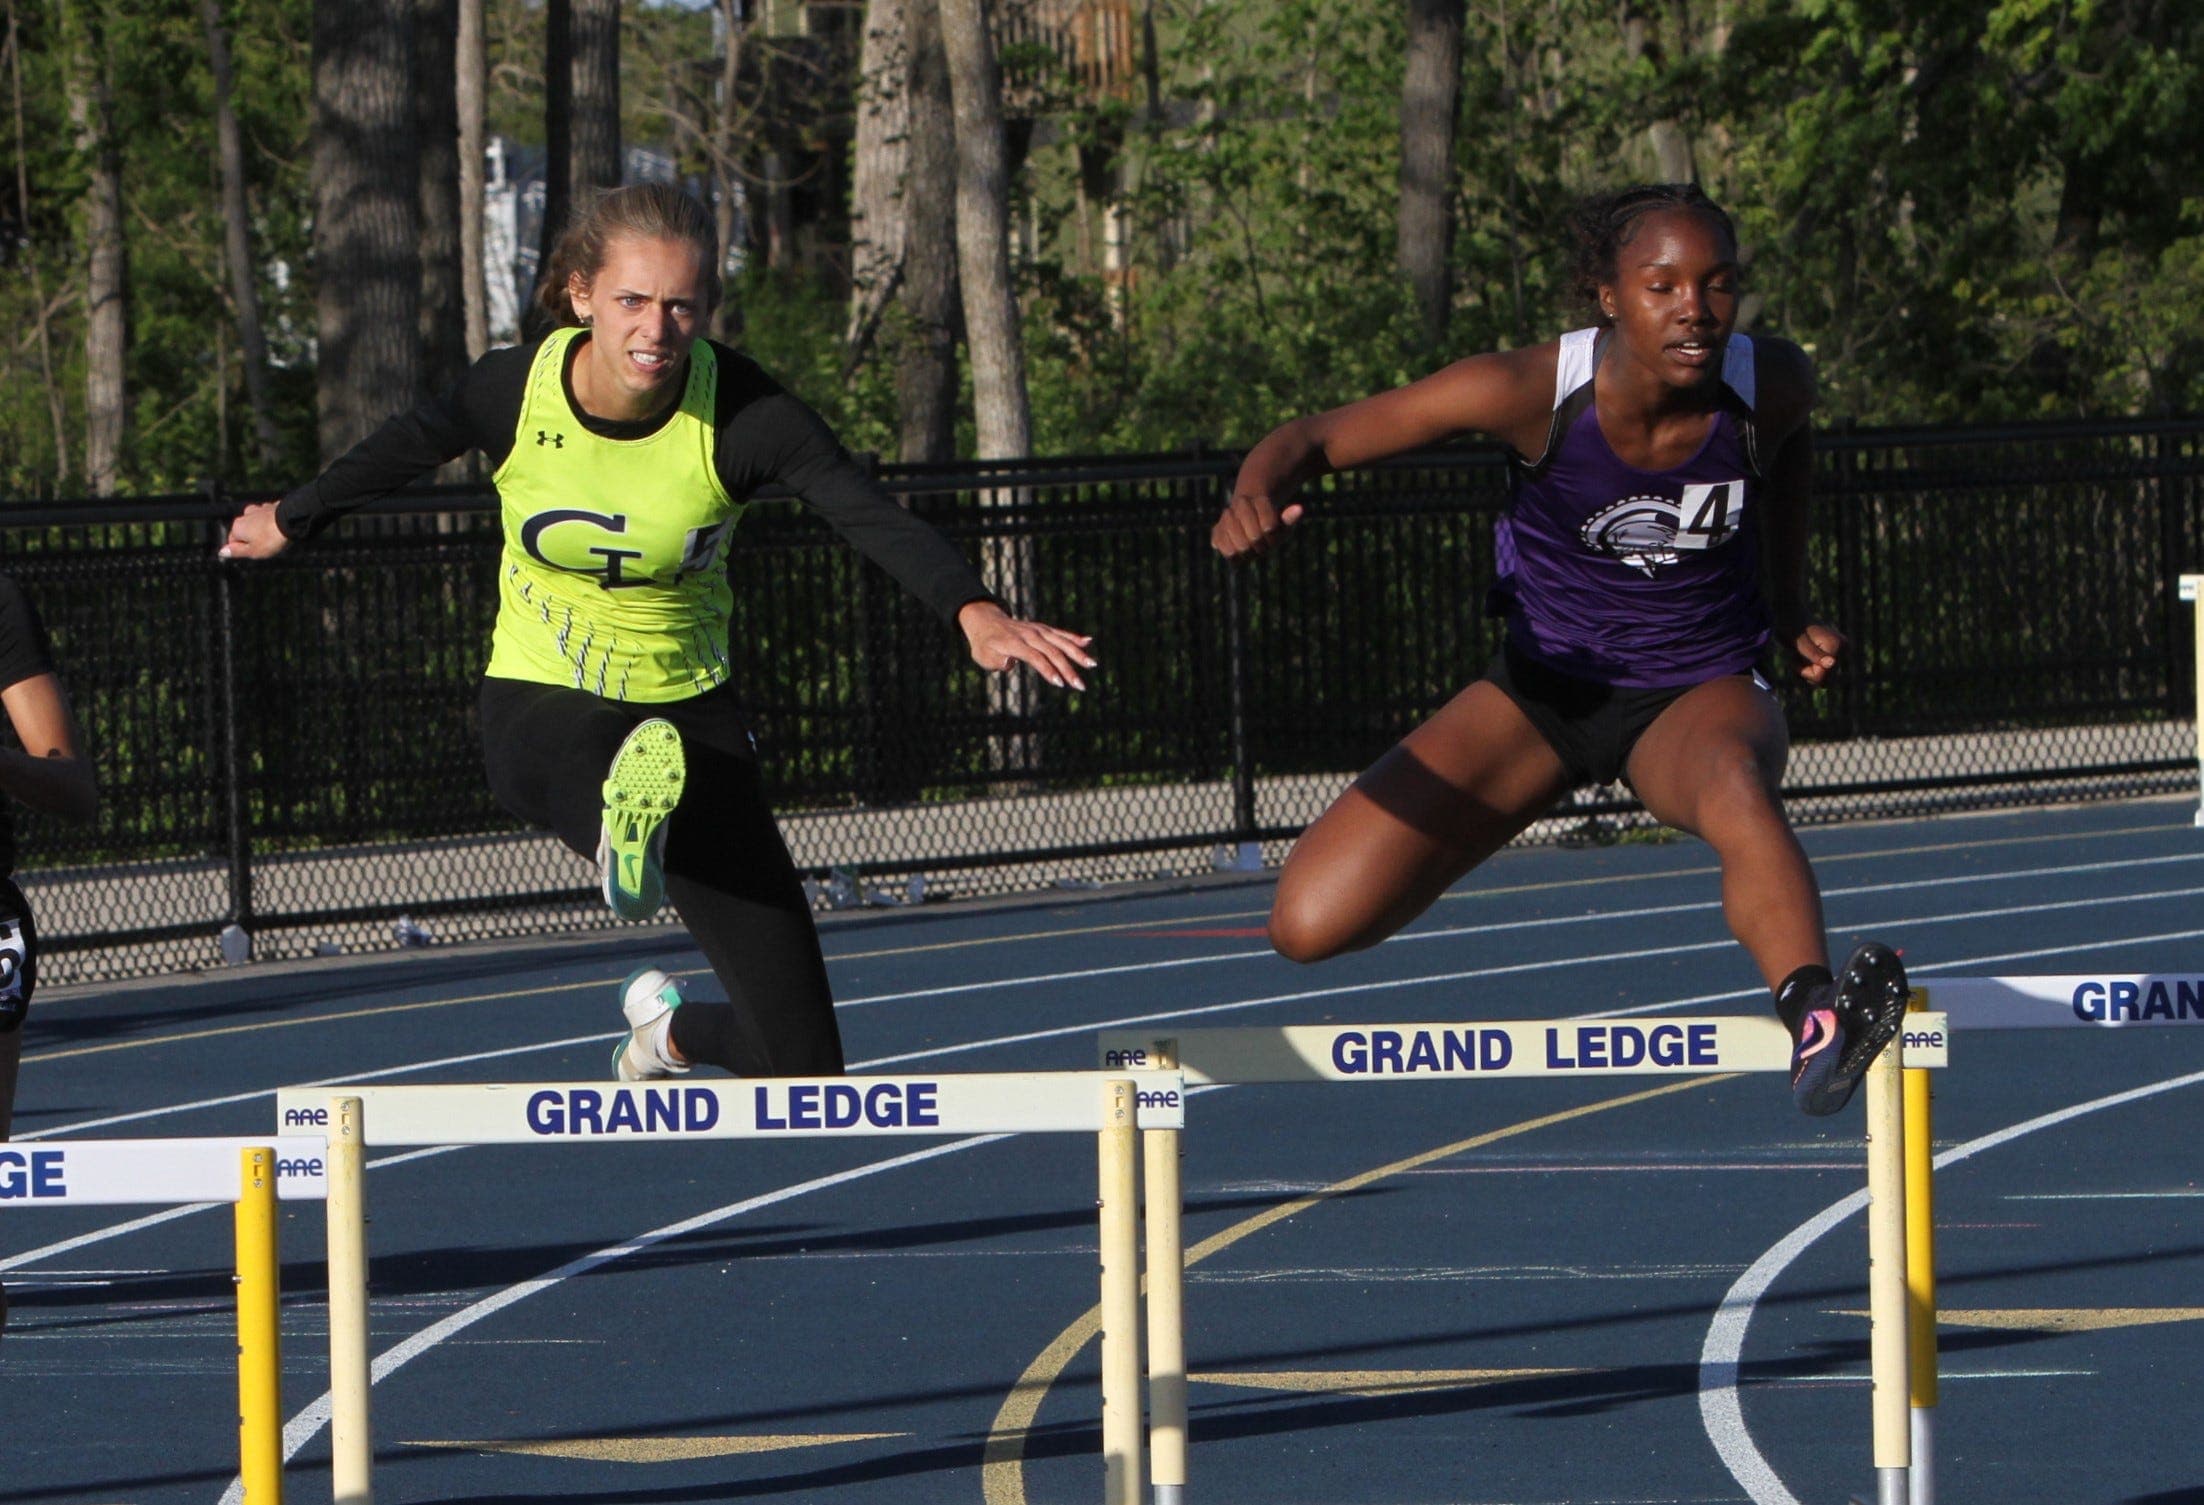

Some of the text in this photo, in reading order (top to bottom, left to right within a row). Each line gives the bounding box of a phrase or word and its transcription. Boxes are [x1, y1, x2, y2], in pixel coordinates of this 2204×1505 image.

[1687, 483, 1732, 546] 4
[1332, 1024, 1719, 1073] GRAND LEDGE
[526, 1083, 939, 1135] GRAND LEDGE
